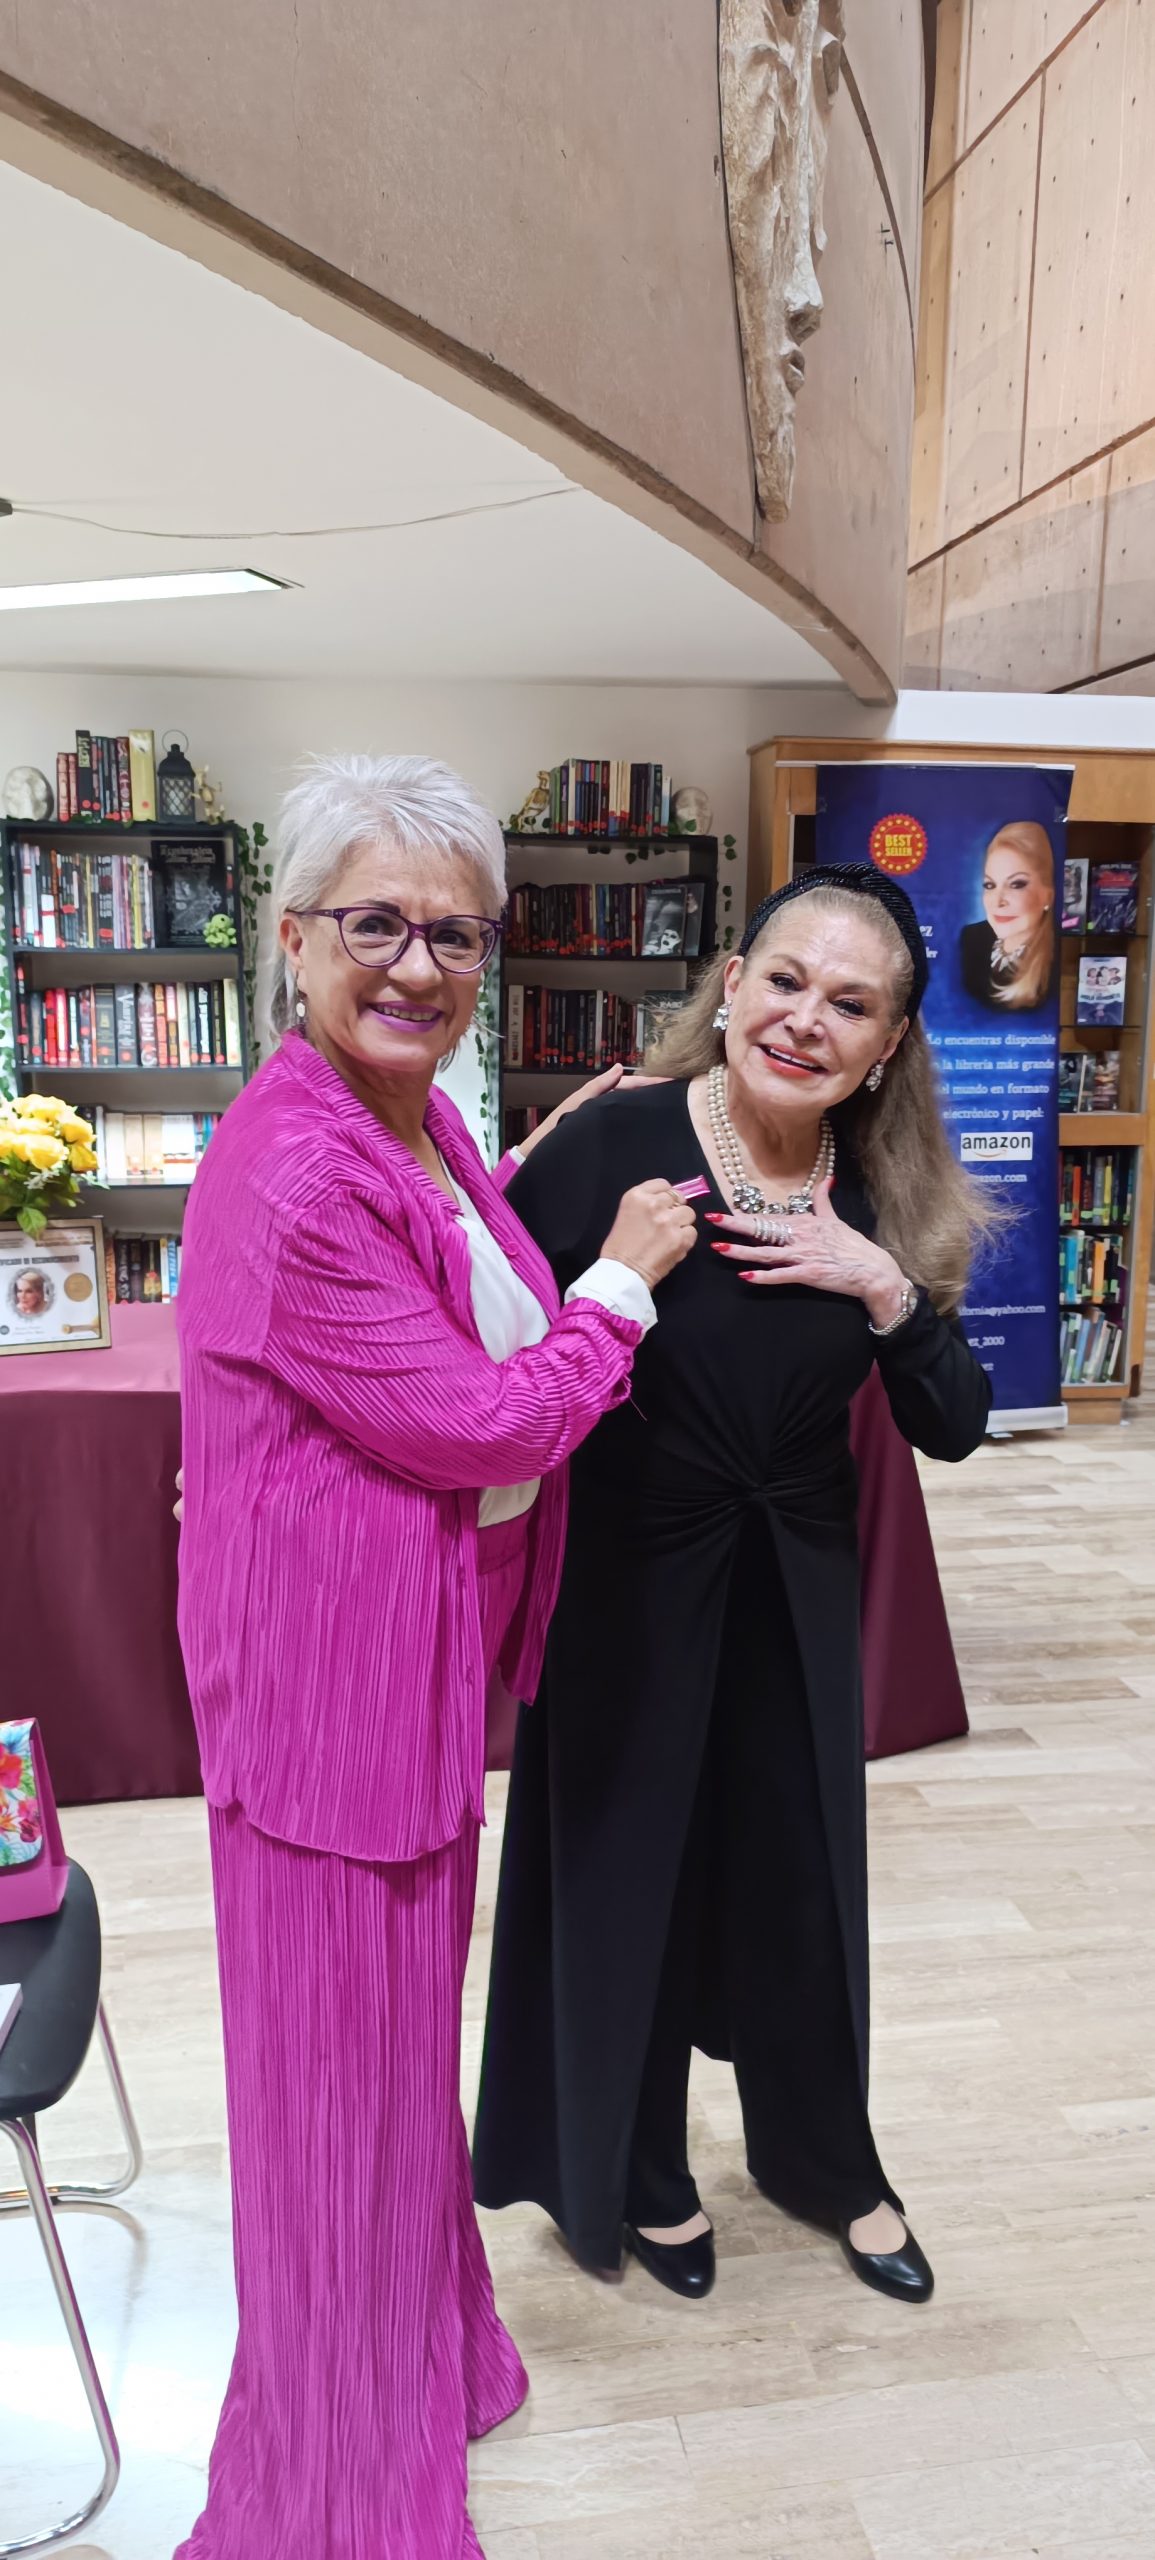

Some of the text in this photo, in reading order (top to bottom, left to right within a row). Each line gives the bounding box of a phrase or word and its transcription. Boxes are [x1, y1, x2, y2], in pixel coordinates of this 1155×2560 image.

[885, 834, 912, 847] BEST
[885, 847, 912, 856] SELLER
[944, 1036, 1001, 1045] encuentras
[1005, 1034, 1056, 1047] disponible
[942, 1059, 952, 1070] la
[1022, 1059, 1055, 1072] grande
[953, 1083, 988, 1095] mundo
[990, 1086, 1004, 1094] en
[1007, 1083, 1049, 1094] formato
[1002, 1109, 1010, 1120] y
[962, 1136, 1031, 1150] amazon
